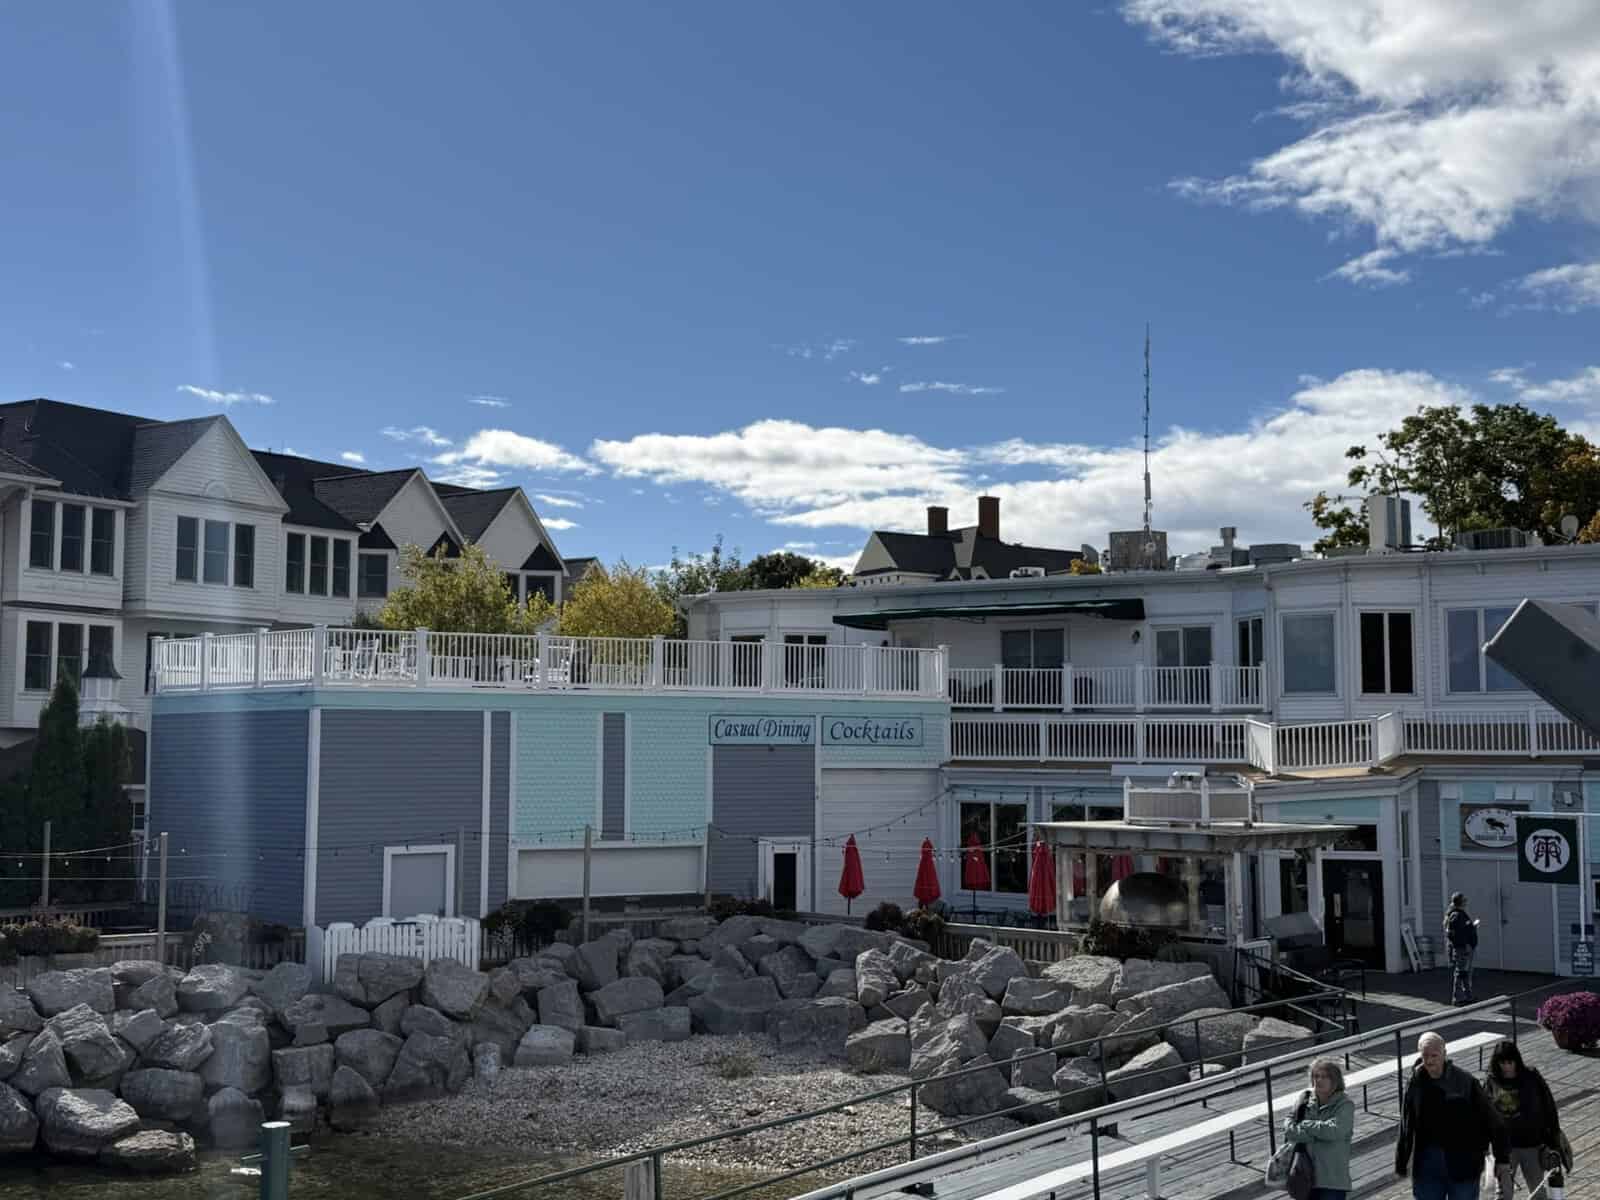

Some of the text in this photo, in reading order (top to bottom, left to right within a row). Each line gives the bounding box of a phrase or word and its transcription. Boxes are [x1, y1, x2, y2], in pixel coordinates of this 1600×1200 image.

[714, 718, 811, 743] Casual Dining
[830, 719, 915, 743] Cocktails
